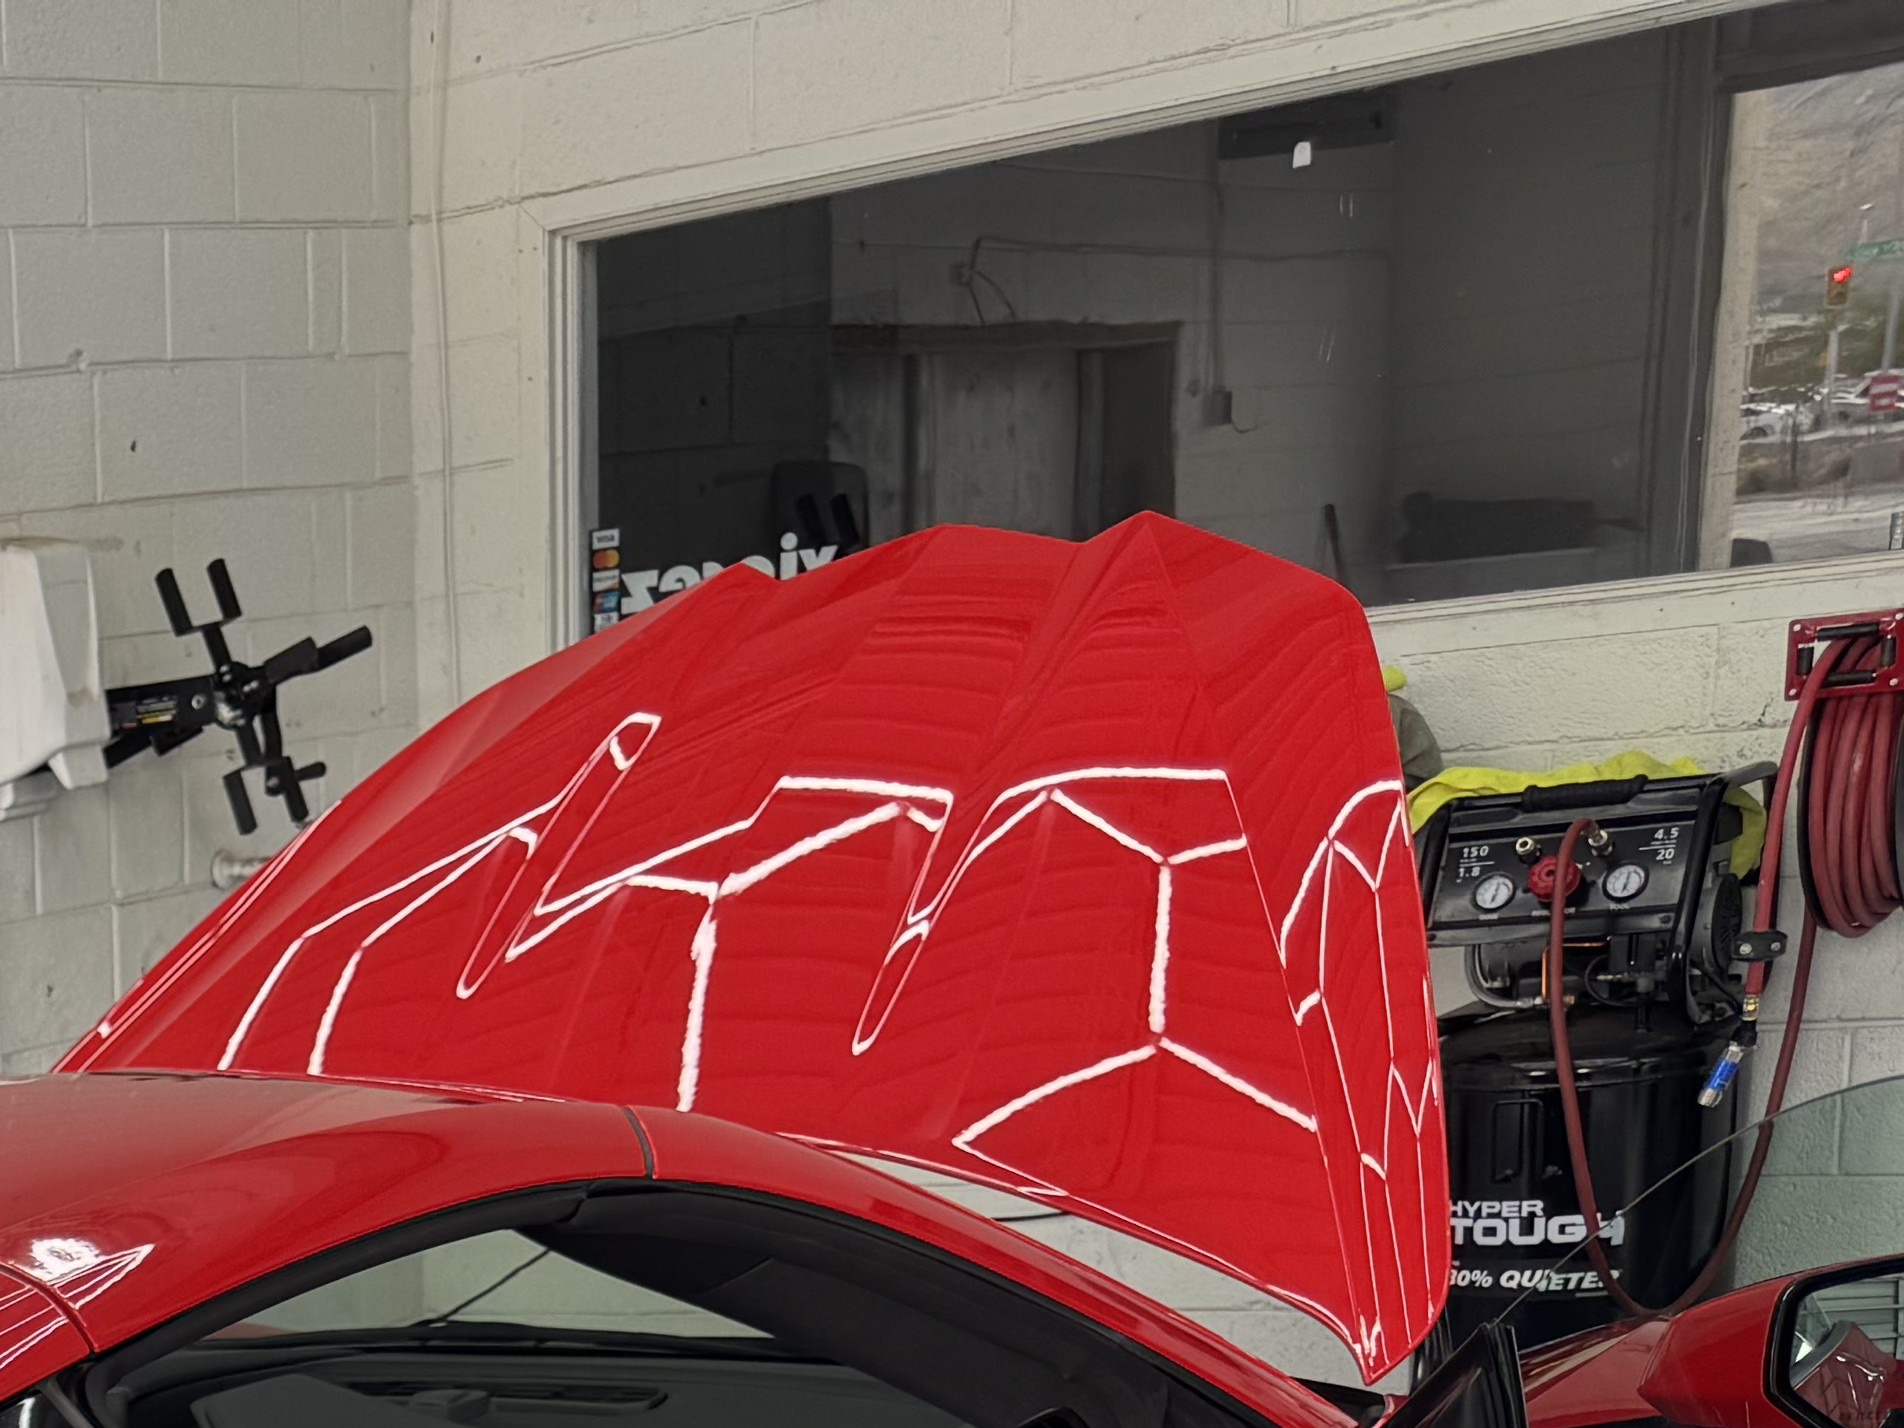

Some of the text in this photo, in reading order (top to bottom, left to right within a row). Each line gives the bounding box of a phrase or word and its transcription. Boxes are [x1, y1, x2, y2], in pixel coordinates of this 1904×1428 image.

[1654, 827, 1679, 840] 4.5
[1463, 845, 1489, 858] 150
[1656, 848, 1674, 861] 20
[1450, 1200, 1544, 1218] HYPER
